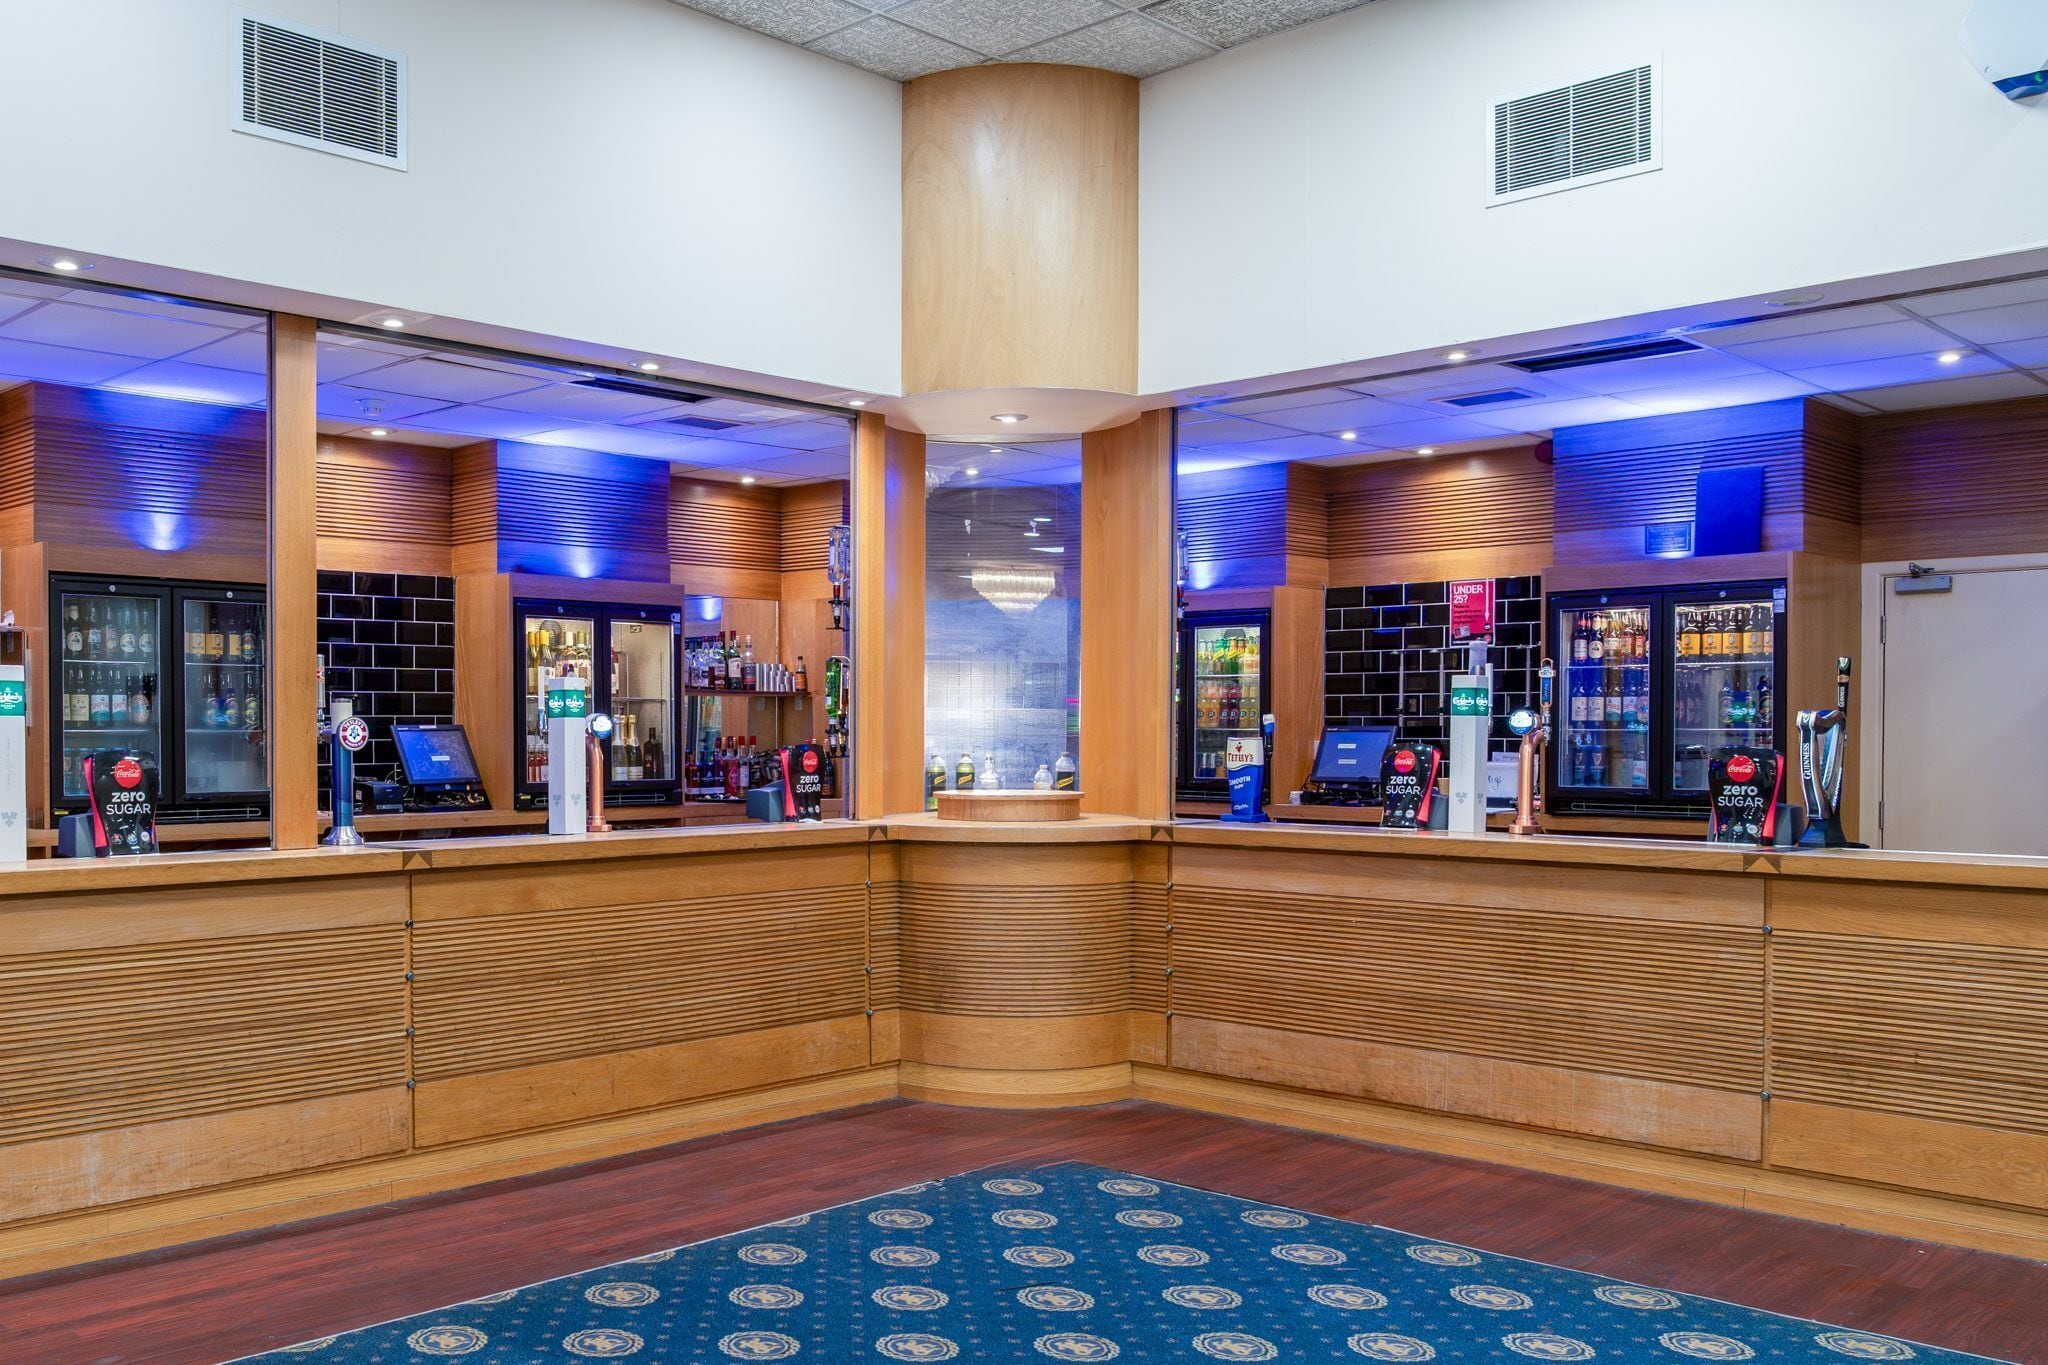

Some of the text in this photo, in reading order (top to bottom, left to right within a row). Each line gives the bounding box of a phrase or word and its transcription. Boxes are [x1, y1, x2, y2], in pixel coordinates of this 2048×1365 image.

[1453, 585, 1483, 595] UNDER
[1453, 595, 1468, 604] 25?
[1803, 742, 1811, 780] GUINNESS
[799, 774, 819, 784] zero
[1229, 775, 1251, 786] SMOOTH
[1390, 775, 1417, 785] zero
[796, 784, 821, 793] SUGAR
[1385, 785, 1421, 795] SUGAR
[1723, 785, 1758, 795] zero
[111, 791, 145, 803] zero
[1717, 796, 1764, 807] SUGAR
[106, 803, 151, 815] SUGAR
